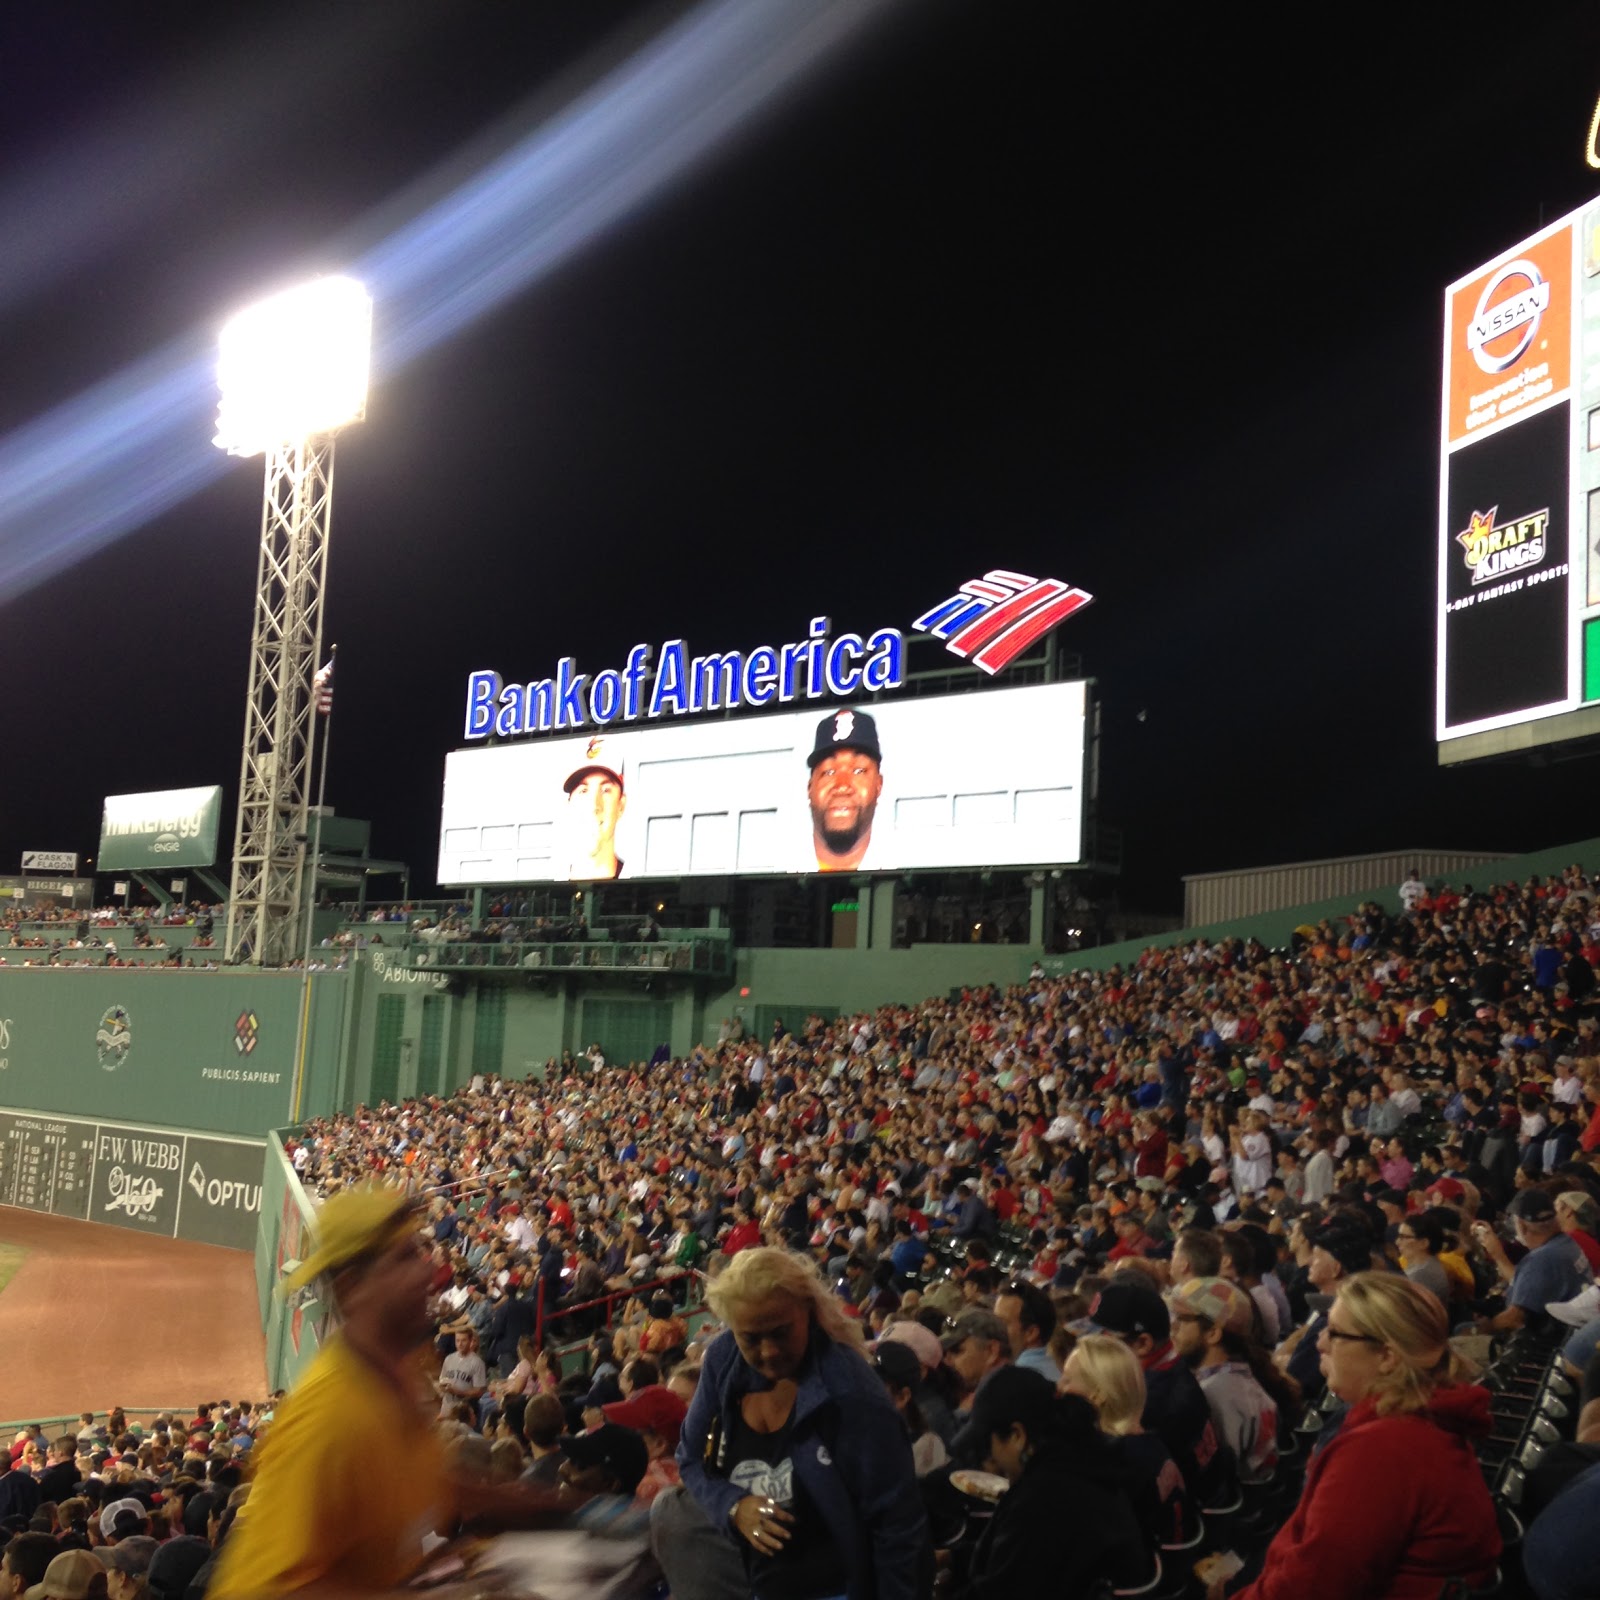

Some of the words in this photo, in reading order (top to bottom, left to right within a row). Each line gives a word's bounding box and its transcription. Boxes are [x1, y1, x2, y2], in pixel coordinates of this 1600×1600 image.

[1476, 296, 1540, 336] NISSAN
[1467, 513, 1546, 566] DRAFT
[1475, 538, 1544, 580] KINGS
[1477, 579, 1524, 602] FANTASY
[1526, 564, 1569, 587] SPORTS
[464, 656, 590, 740] Bank
[589, 643, 653, 725] of
[648, 616, 906, 717] America
[36, 861, 73, 869] FLAGON
[37, 854, 62, 862] CASK
[98, 1135, 128, 1164] F.W.
[131, 1139, 180, 1170] WEBB
[207, 1178, 263, 1212] OPTU
